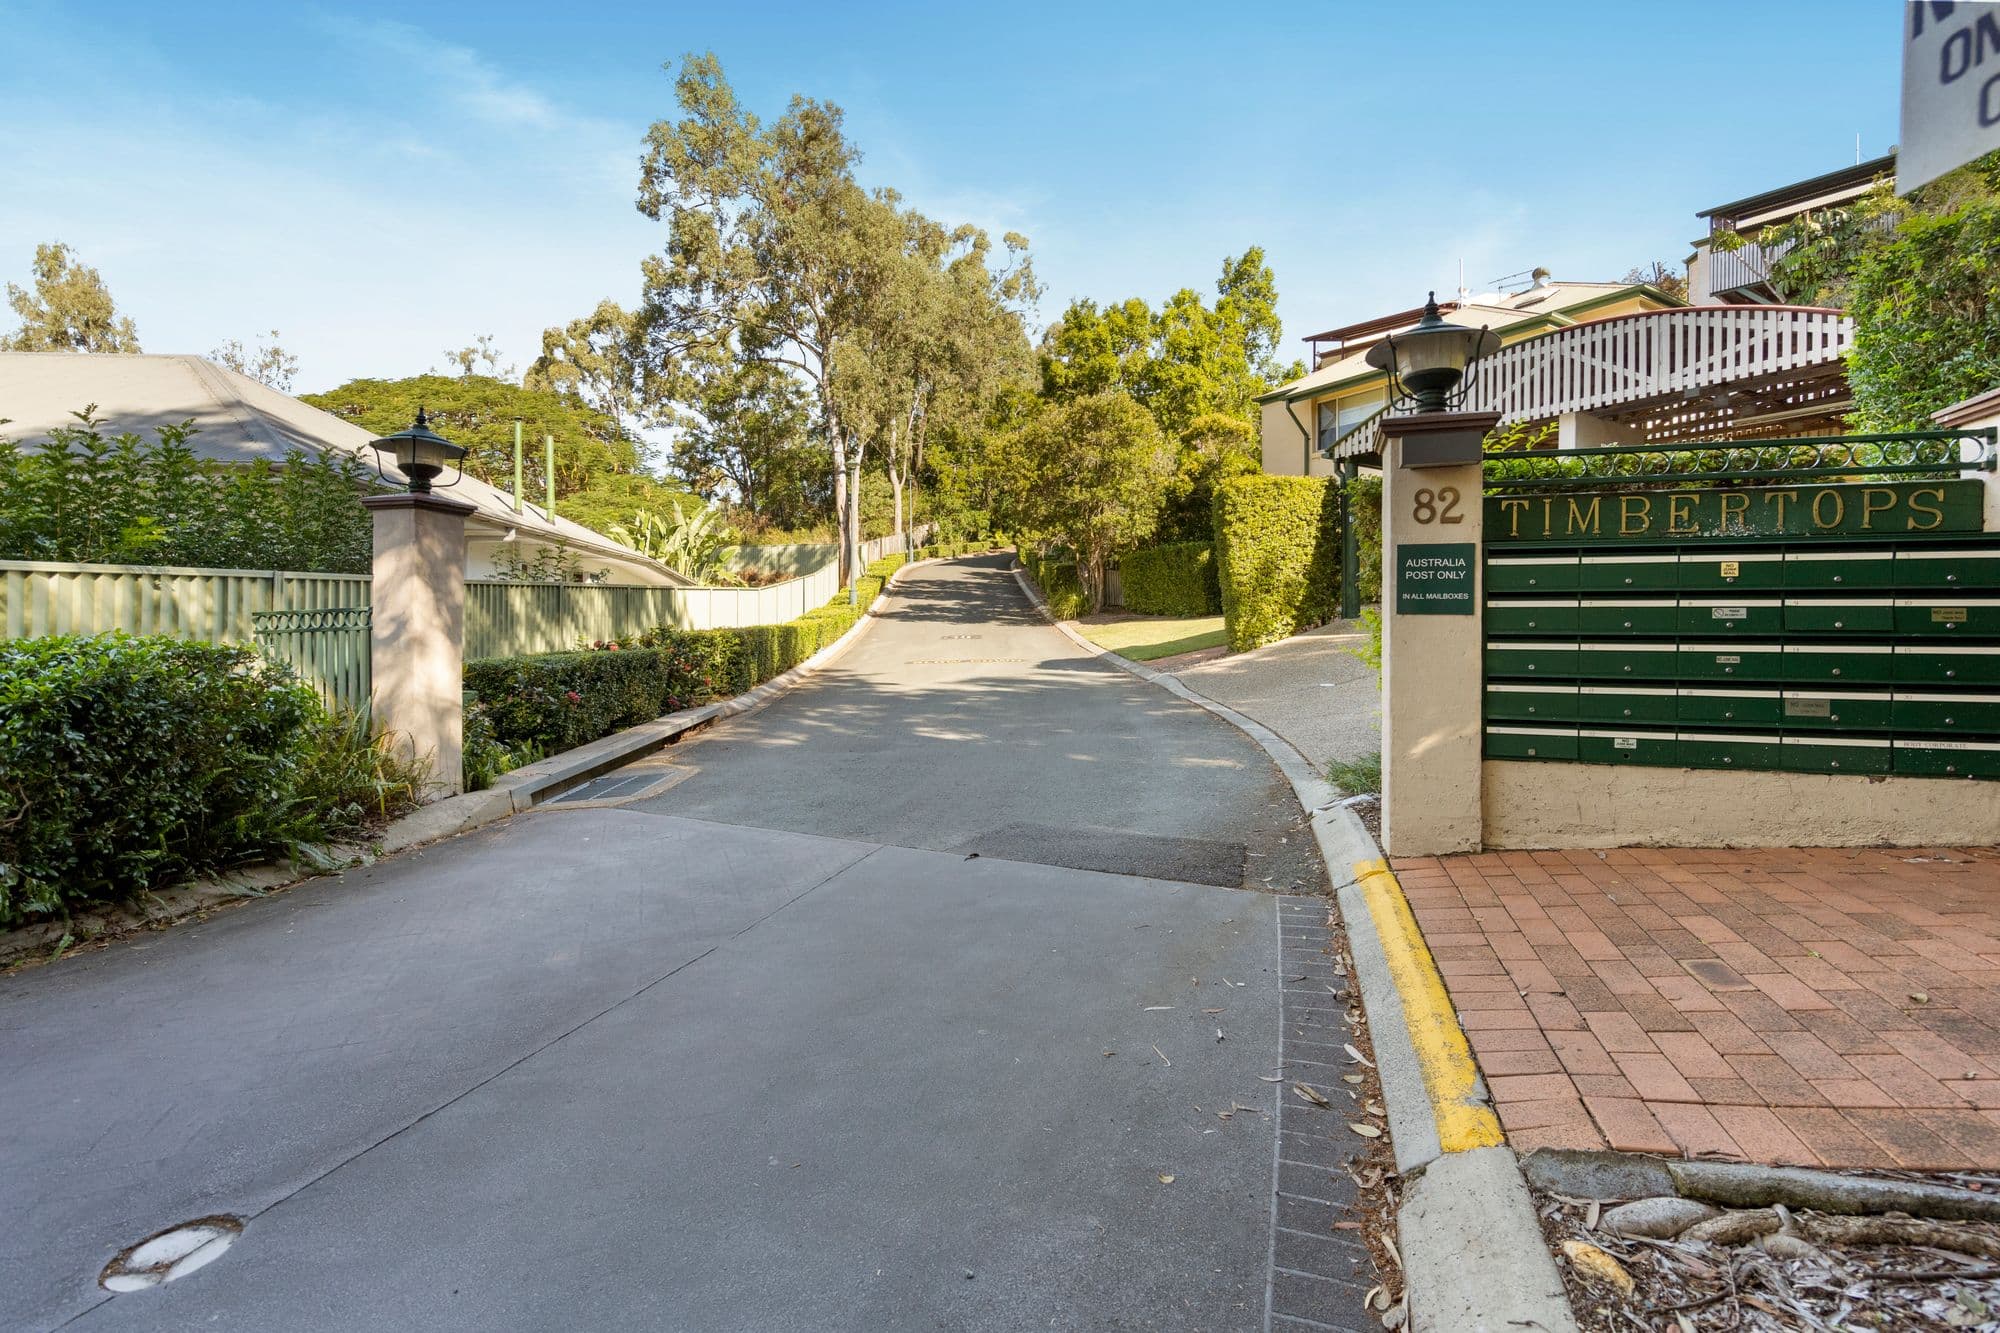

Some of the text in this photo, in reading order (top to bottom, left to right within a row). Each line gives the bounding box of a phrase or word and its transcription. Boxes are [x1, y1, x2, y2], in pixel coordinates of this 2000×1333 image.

[1412, 486, 1464, 525] 82
[1501, 488, 1945, 538] TIMBERTOPS
[1405, 558, 1466, 568] AUSTRALIA
[1405, 571, 1466, 580] POST ONLY
